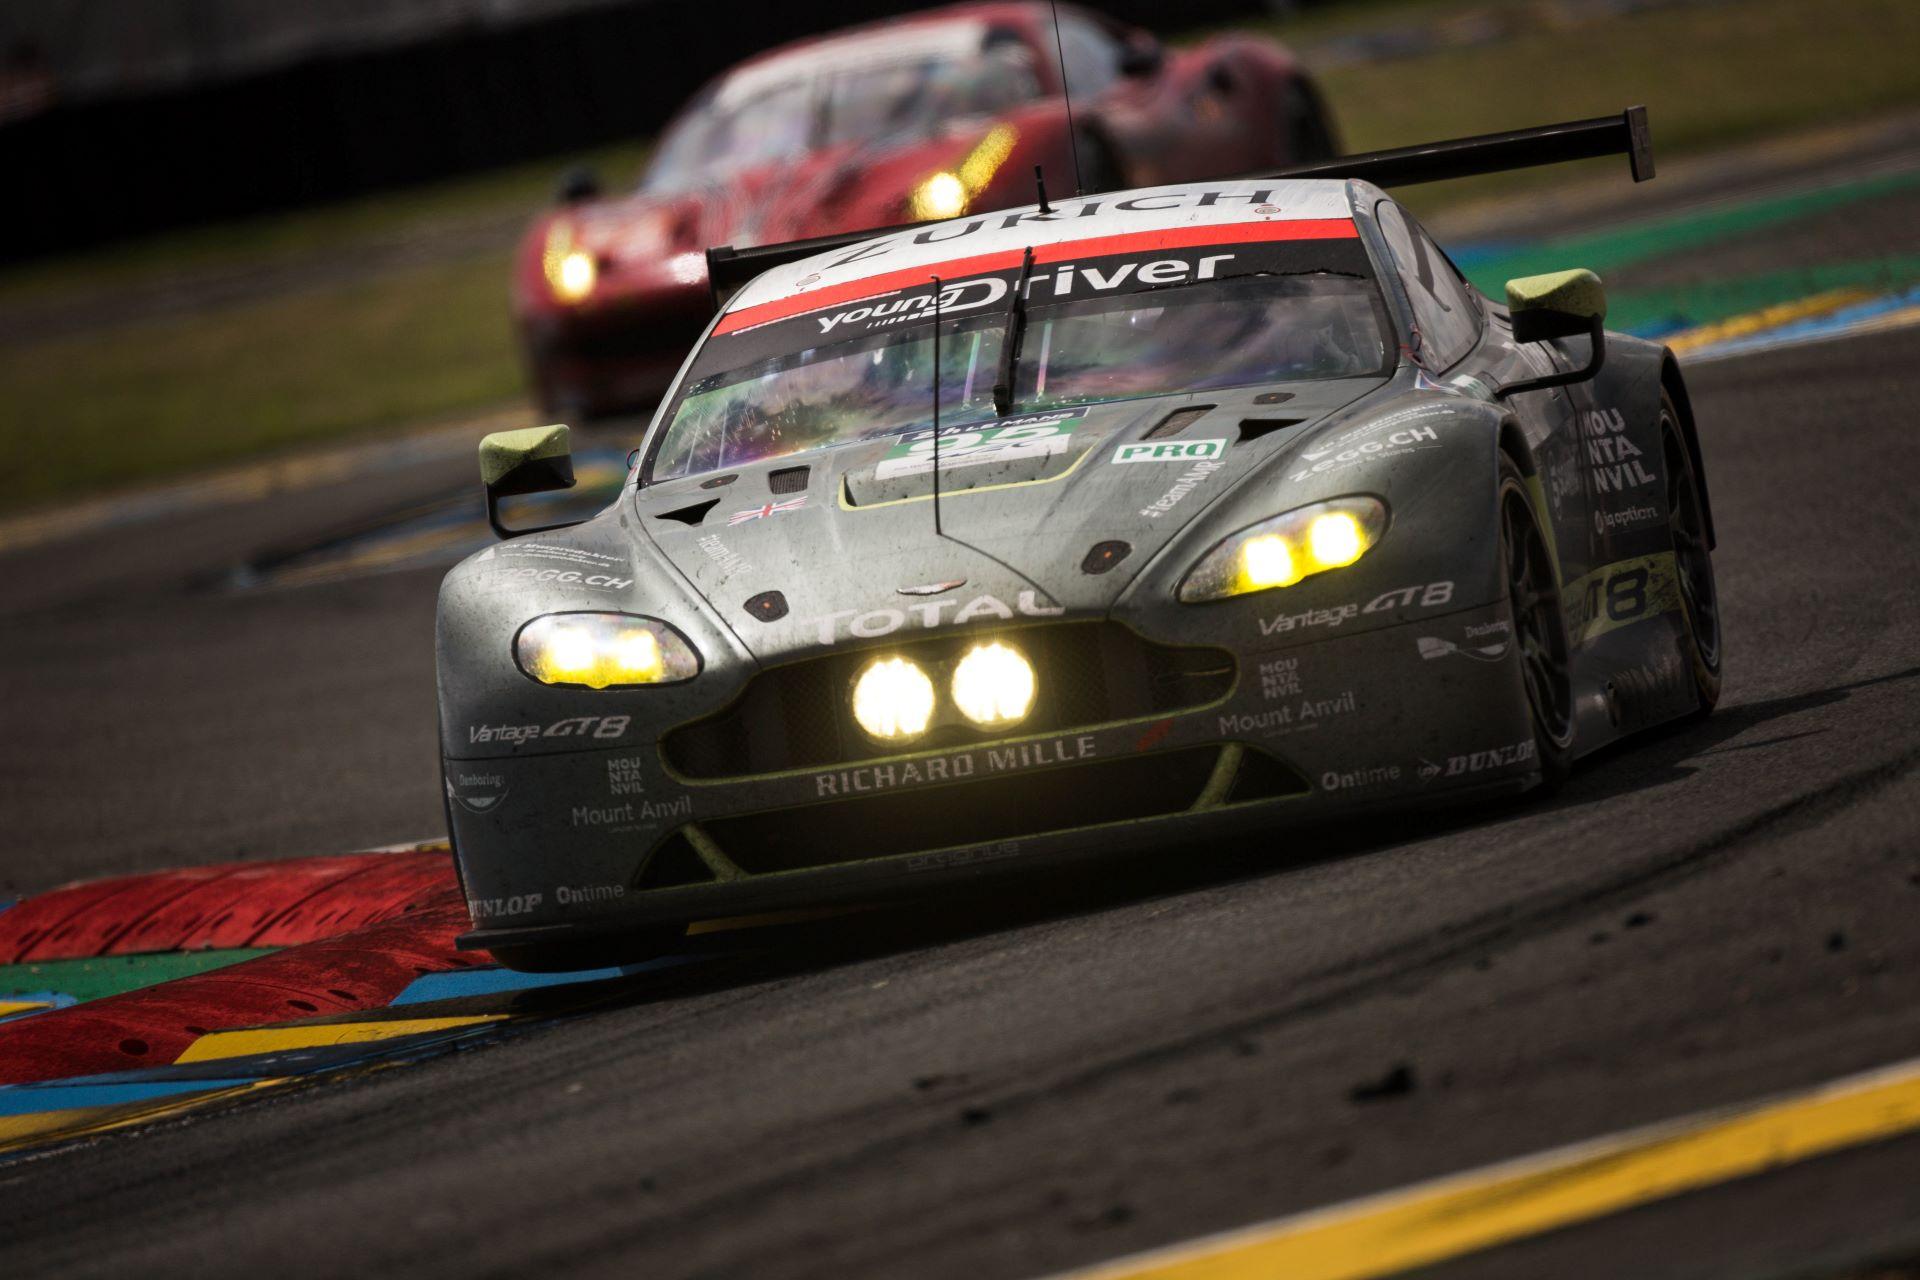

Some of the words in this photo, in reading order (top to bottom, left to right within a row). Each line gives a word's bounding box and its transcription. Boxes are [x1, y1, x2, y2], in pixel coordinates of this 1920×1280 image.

[825, 190, 1275, 270] ZURICH
[1121, 443, 1218, 461] PRO
[1586, 435, 1644, 467] NTA
[1592, 459, 1657, 495] NVIL
[814, 590, 1066, 646] TOTAL
[1259, 603, 1359, 636] Vantage
[1362, 581, 1455, 614] GT8
[1259, 658, 1298, 675] MOU
[1219, 705, 1292, 736] Mount
[1300, 691, 1356, 722] Anvil
[469, 724, 541, 745] Vantage
[543, 715, 632, 739] GT8
[607, 757, 641, 771] MOU
[608, 770, 643, 784] NTA
[816, 754, 974, 798] RICHARD
[988, 736, 1097, 772] MILLE
[1321, 767, 1400, 791] Ontime
[610, 782, 645, 796] NVIL
[572, 803, 635, 827] Mount
[640, 795, 693, 820] Anvil
[556, 884, 625, 905] Ontime
